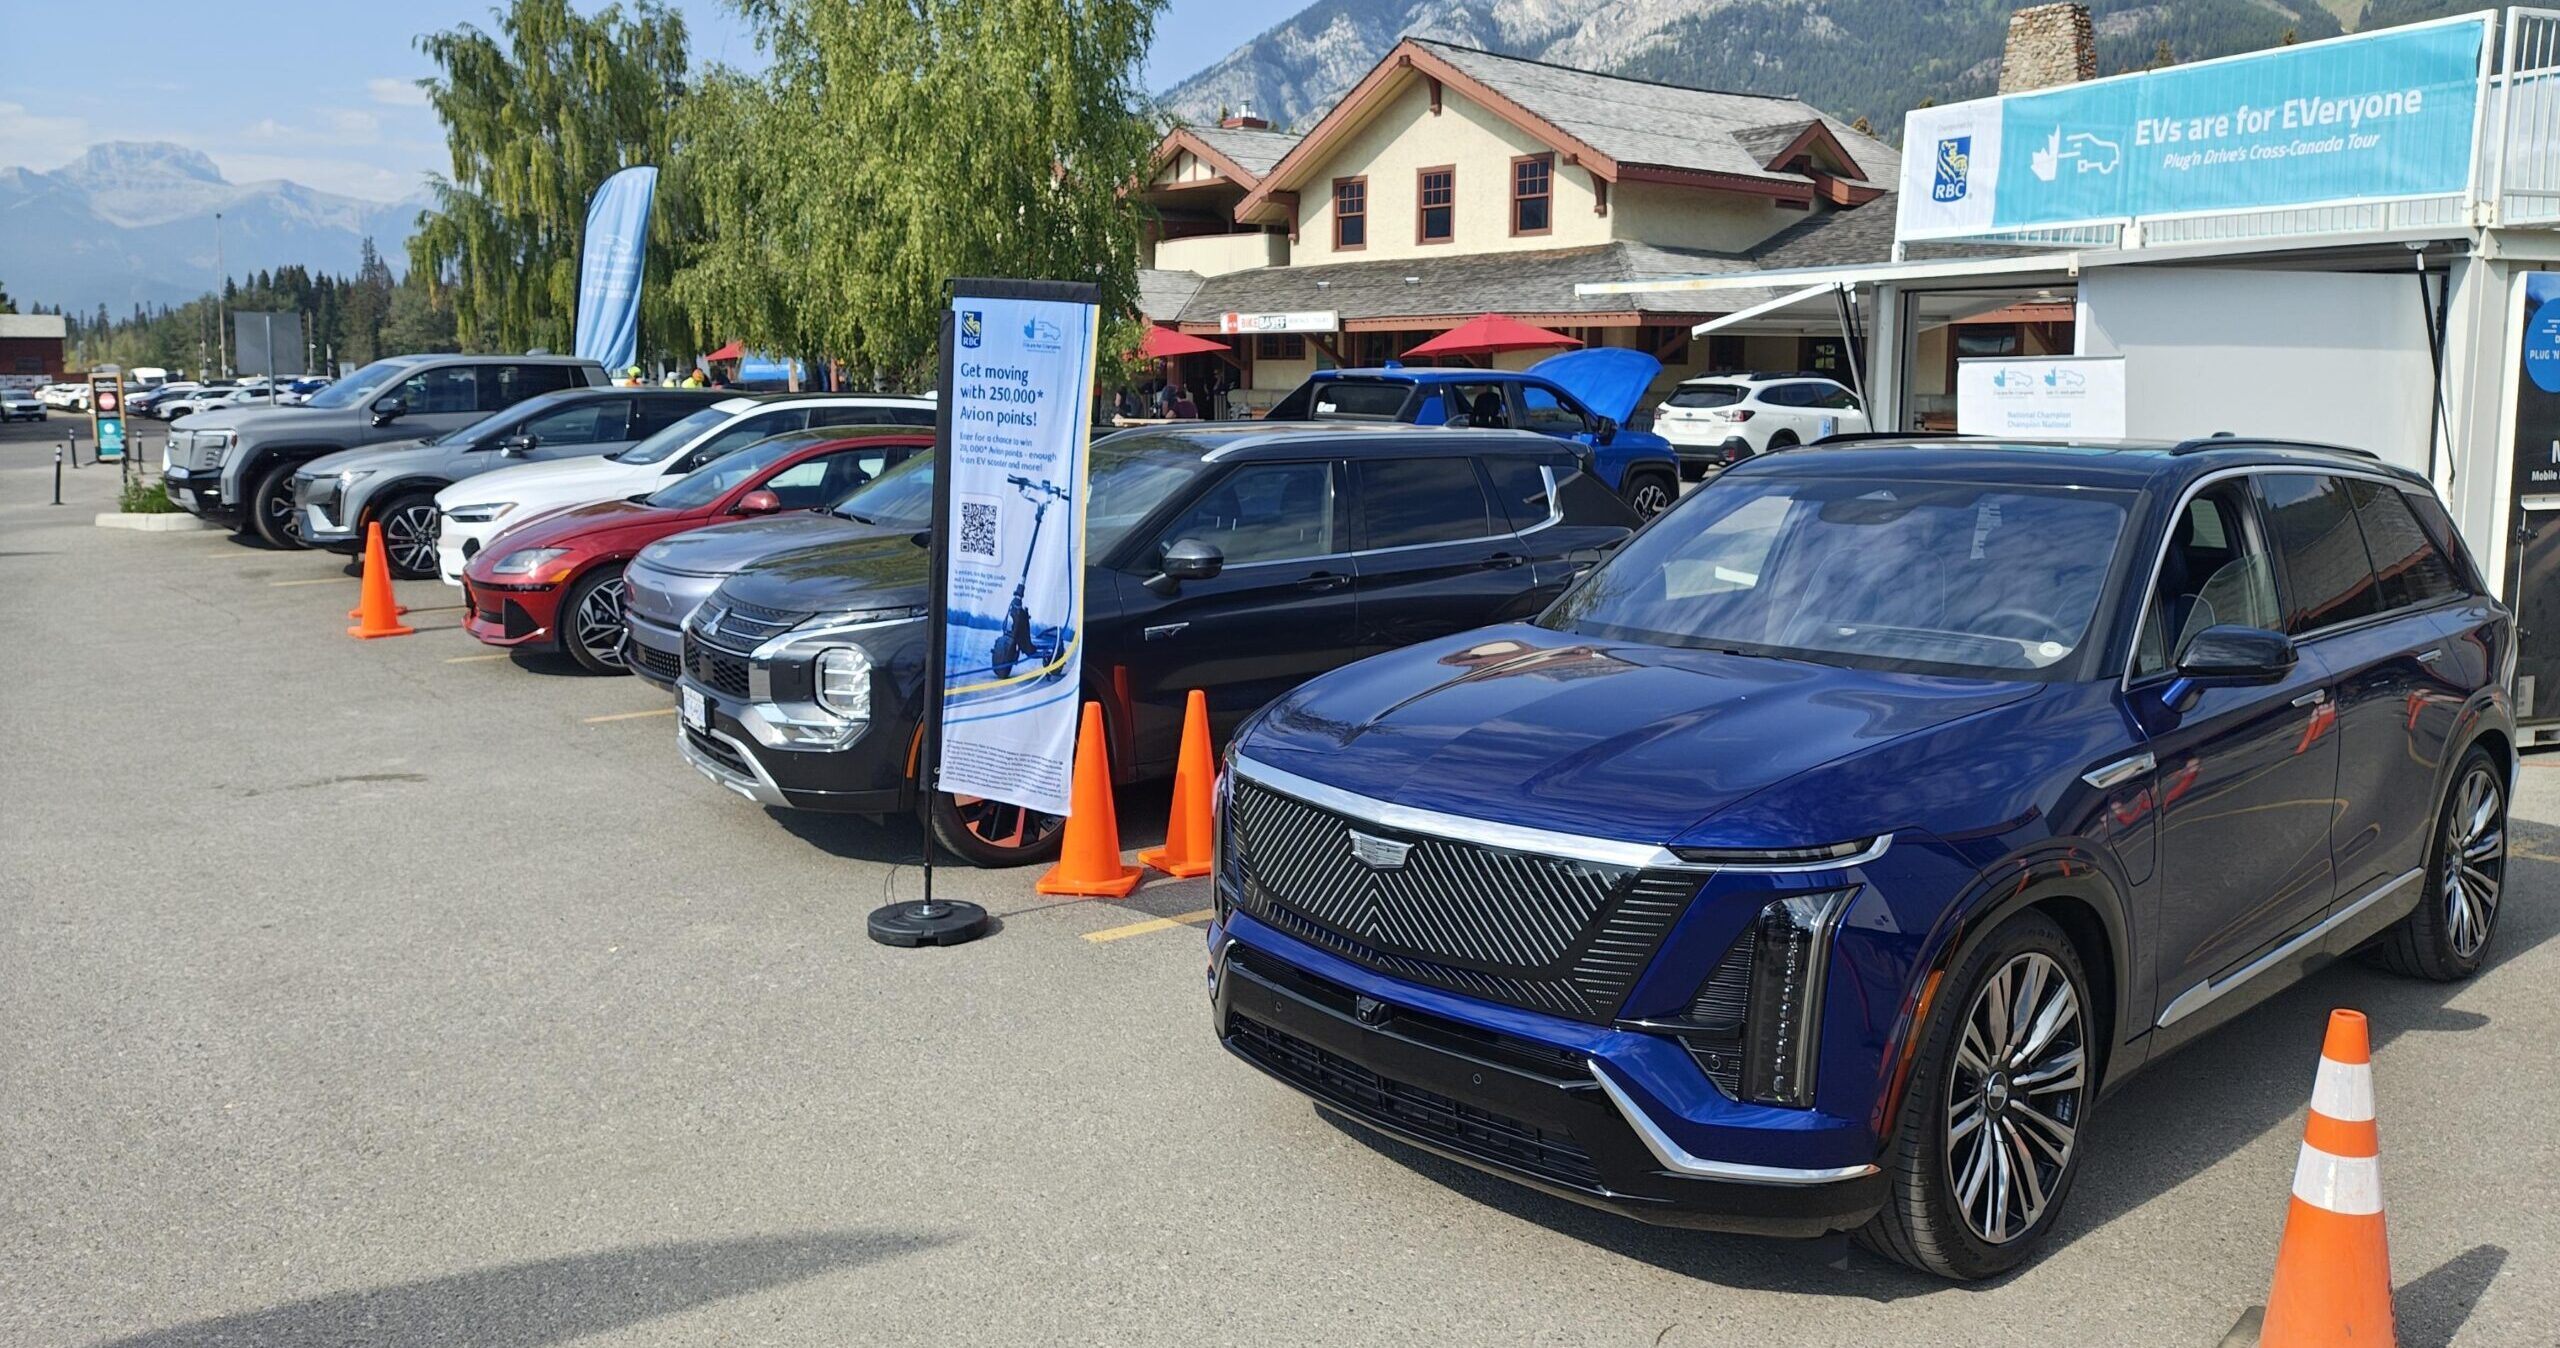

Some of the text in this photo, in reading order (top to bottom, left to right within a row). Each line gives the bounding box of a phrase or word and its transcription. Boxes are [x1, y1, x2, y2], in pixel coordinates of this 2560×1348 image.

[2135, 89, 2422, 146] EVs are for EVeryone
[2203, 148, 2247, 165] Drive's
[2249, 135, 2343, 161] Cross-Canada
[2348, 132, 2381, 150] Tour
[1935, 182, 1965, 199] RBC
[963, 337, 979, 346] RBC
[2530, 350, 2550, 360] PLUG
[960, 363, 1029, 386] Get moving
[960, 384, 985, 399] with
[960, 406, 1037, 427] Avion points!
[975, 432, 985, 442] for
[1020, 439, 1032, 447] win
[976, 457, 986, 465] EV
[1028, 452, 1057, 463] enough
[2532, 469, 2558, 481] Mobile
